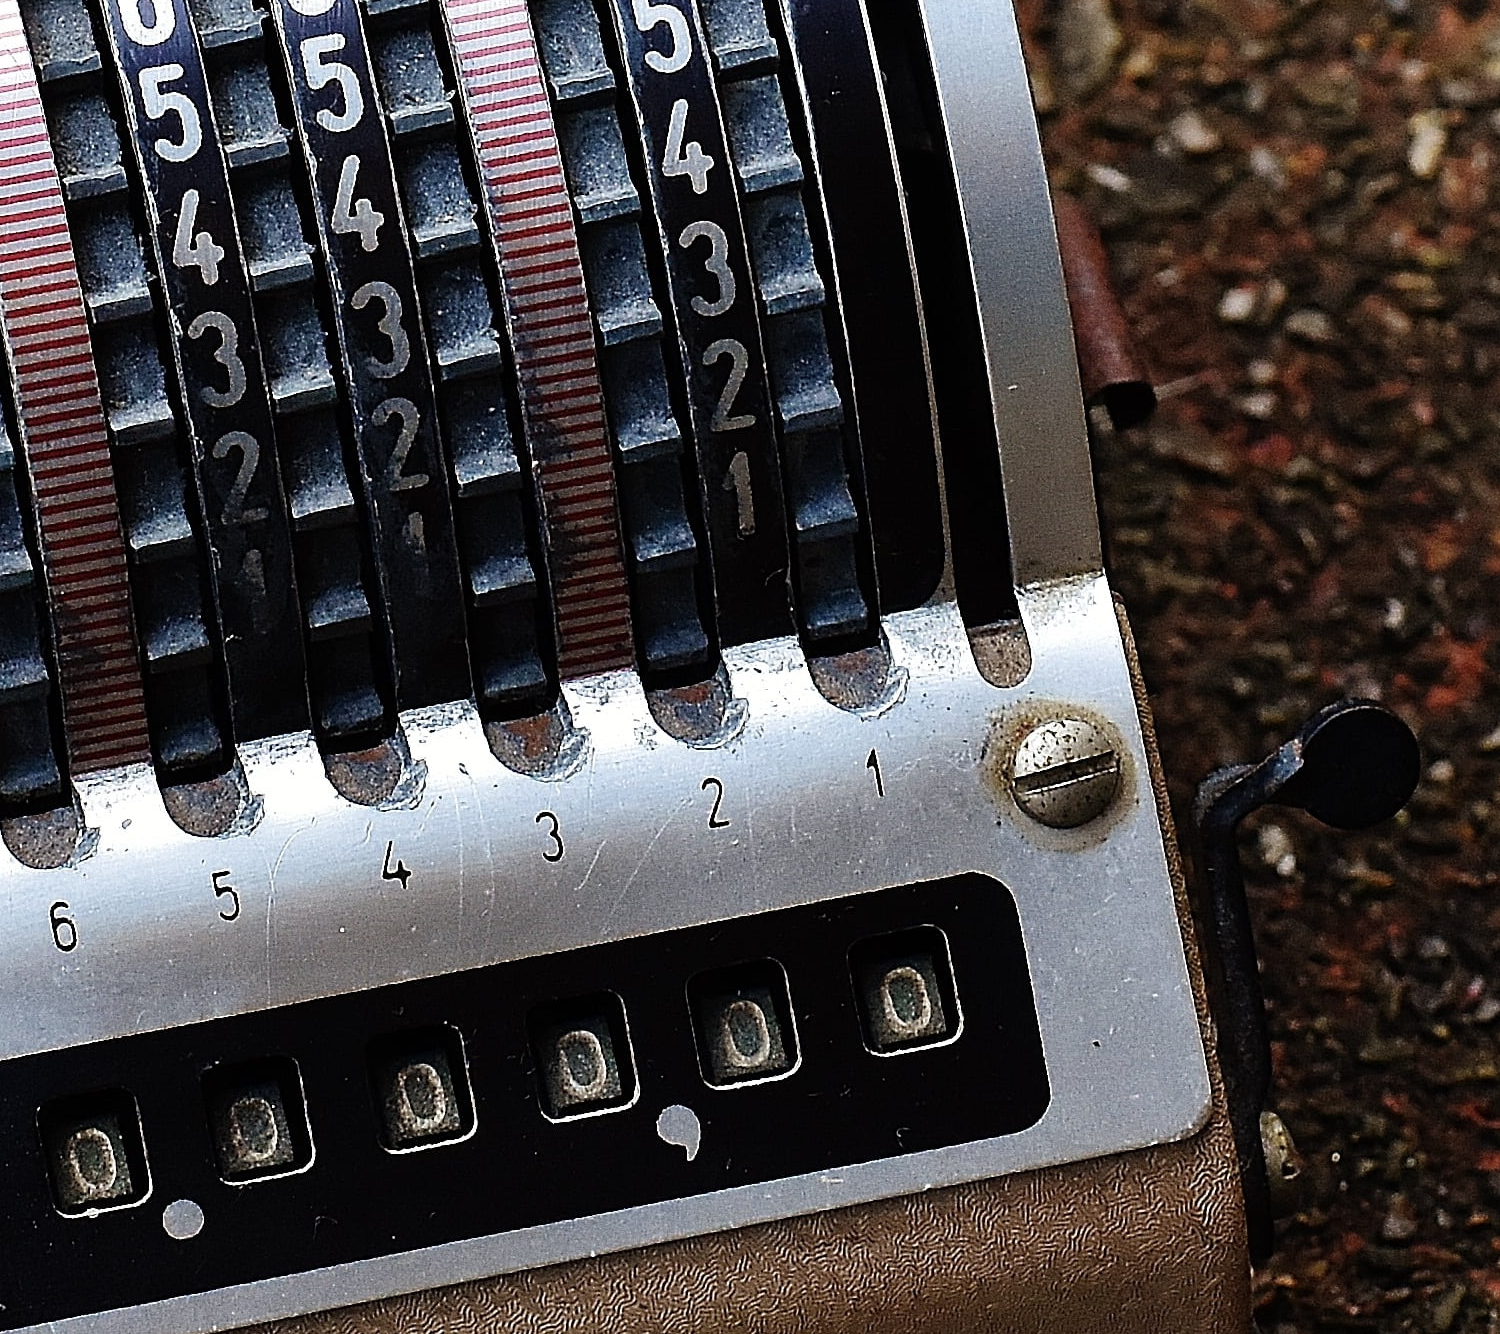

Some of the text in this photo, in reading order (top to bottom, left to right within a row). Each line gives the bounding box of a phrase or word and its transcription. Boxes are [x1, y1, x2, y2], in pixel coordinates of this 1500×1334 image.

[138, 65, 202, 163] 5
[299, 33, 363, 133] 5
[662, 98, 715, 194] 4
[172, 189, 224, 285] 4
[330, 154, 384, 252] 4
[678, 220, 737, 317] 3
[187, 310, 246, 409] 3
[350, 280, 411, 380] 3
[701, 337, 756, 433] 2
[212, 430, 270, 525] 2
[371, 397, 430, 491] 2
[723, 452, 755, 540] 1
[50, 901, 78, 953] 6
[211, 870, 239, 921] 5
[381, 840, 412, 890] 4
[535, 811, 564, 863] 3
[701, 777, 730, 829] 2
[866, 748, 885, 797] 1
